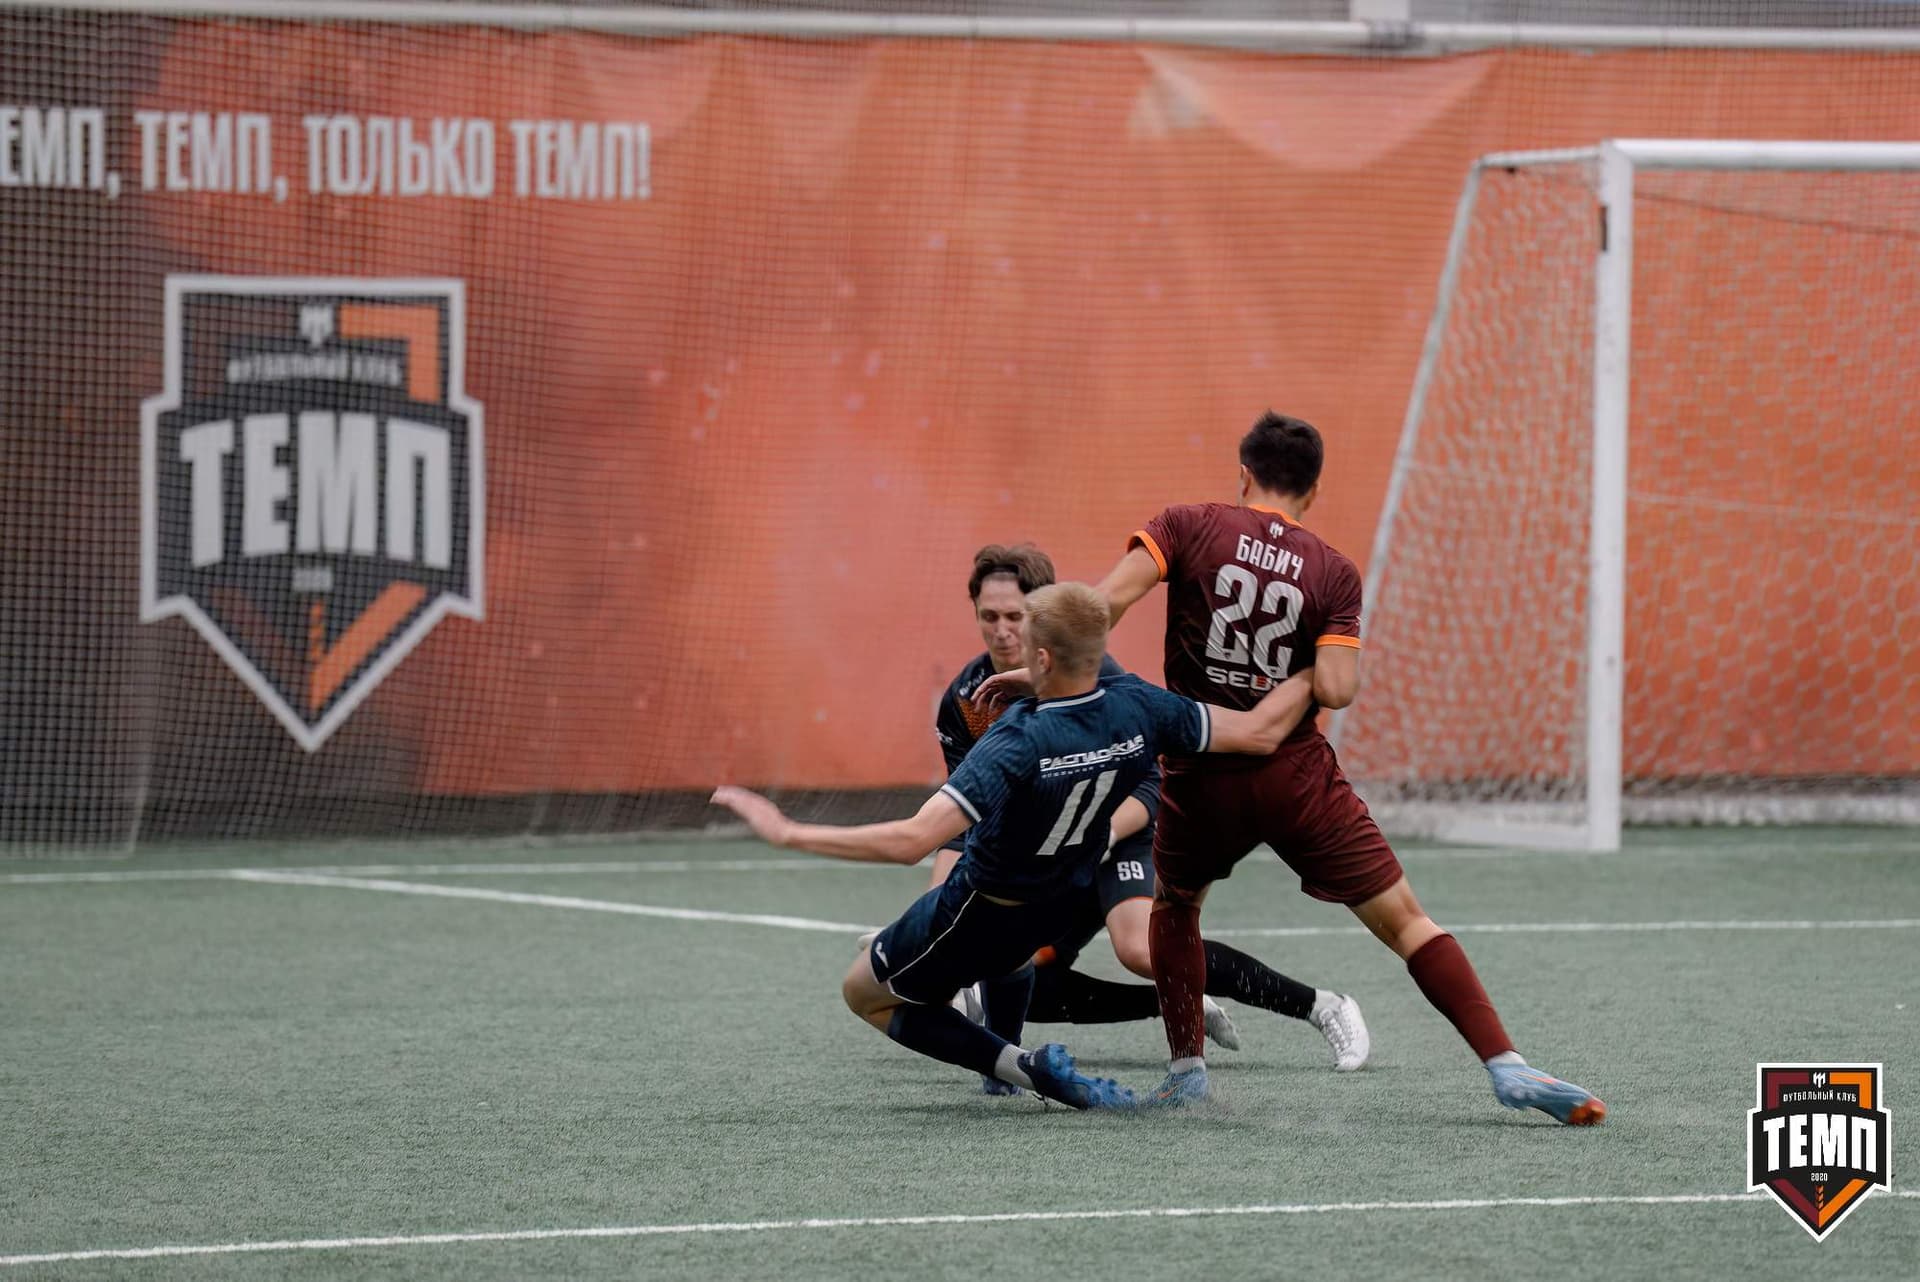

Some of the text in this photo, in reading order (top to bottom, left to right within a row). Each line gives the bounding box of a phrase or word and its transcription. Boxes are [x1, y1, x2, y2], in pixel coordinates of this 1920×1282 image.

[133, 110, 288, 203] ТЕМП,
[302, 114, 496, 199] ТОЛЬКО
[509, 118, 652, 201] ТЕМП!
[180, 410, 451, 571] ТЕМП
[1231, 533, 1304, 581] БАБИЧ
[1205, 563, 1304, 679] 22
[1036, 769, 1118, 856] 11
[1116, 860, 1145, 881] 59
